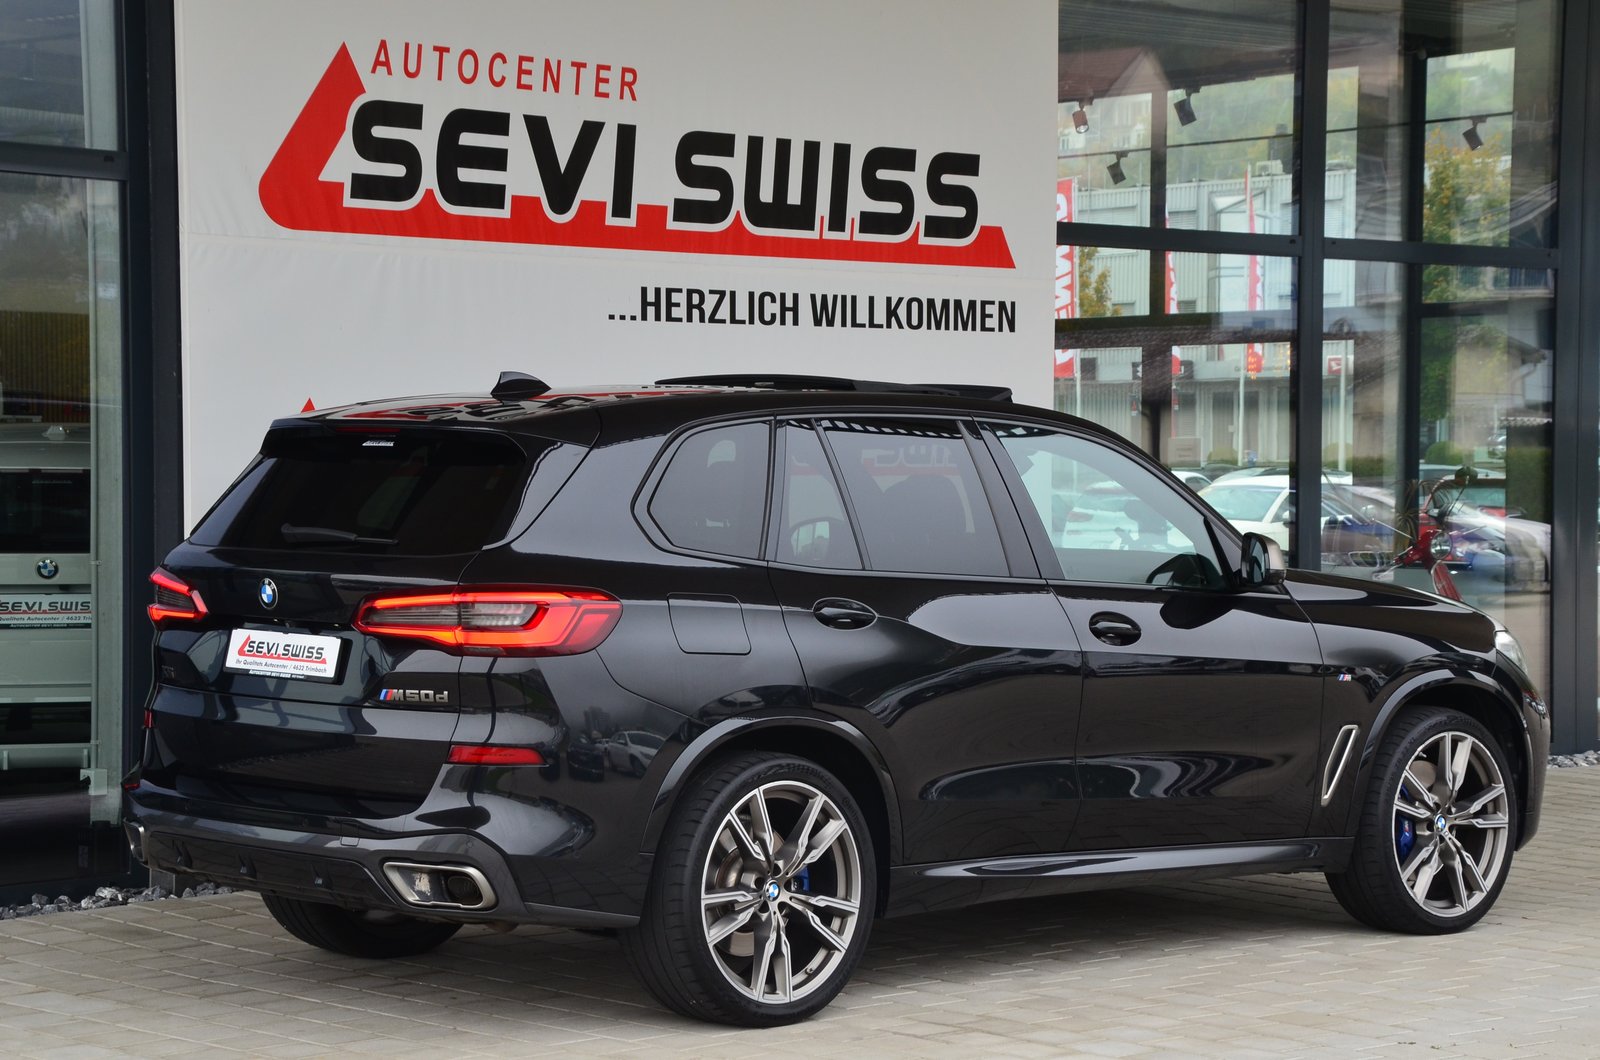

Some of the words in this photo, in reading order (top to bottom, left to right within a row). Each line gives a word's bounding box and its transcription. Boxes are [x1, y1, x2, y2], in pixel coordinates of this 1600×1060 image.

[371, 39, 638, 102] AUTOCENTER
[349, 99, 637, 219] SEVI
[672, 130, 981, 240] SWISS
[809, 293, 1016, 333] WILLKOMMEN
[246, 640, 280, 655] SEVI
[281, 643, 324, 660] SWISS
[388, 689, 449, 703] M50d
